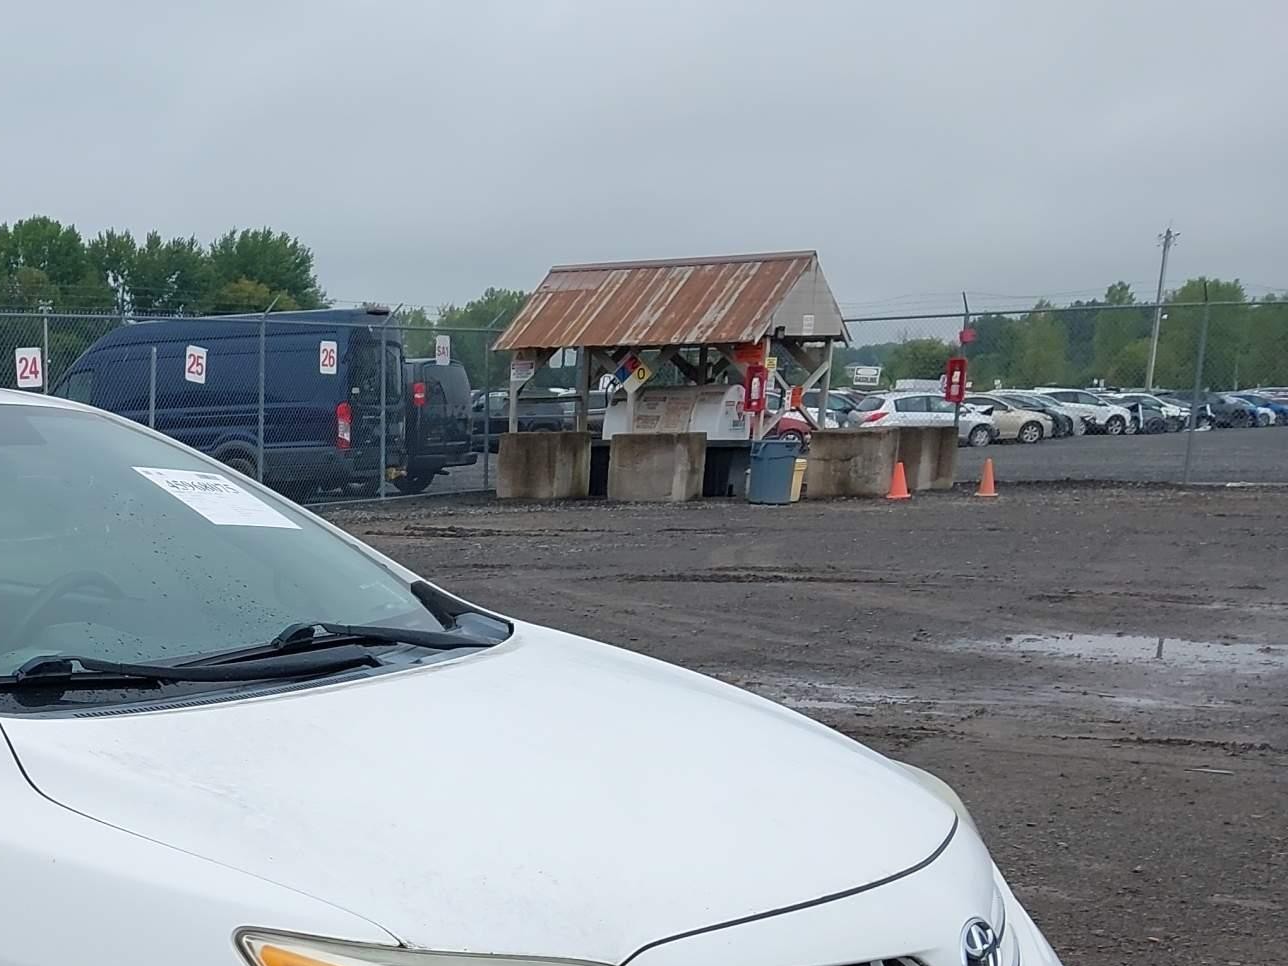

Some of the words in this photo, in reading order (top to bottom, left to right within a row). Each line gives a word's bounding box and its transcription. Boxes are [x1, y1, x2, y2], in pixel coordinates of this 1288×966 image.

[18, 356, 39, 379] 24
[187, 353, 204, 376] 25
[321, 348, 335, 367] 26
